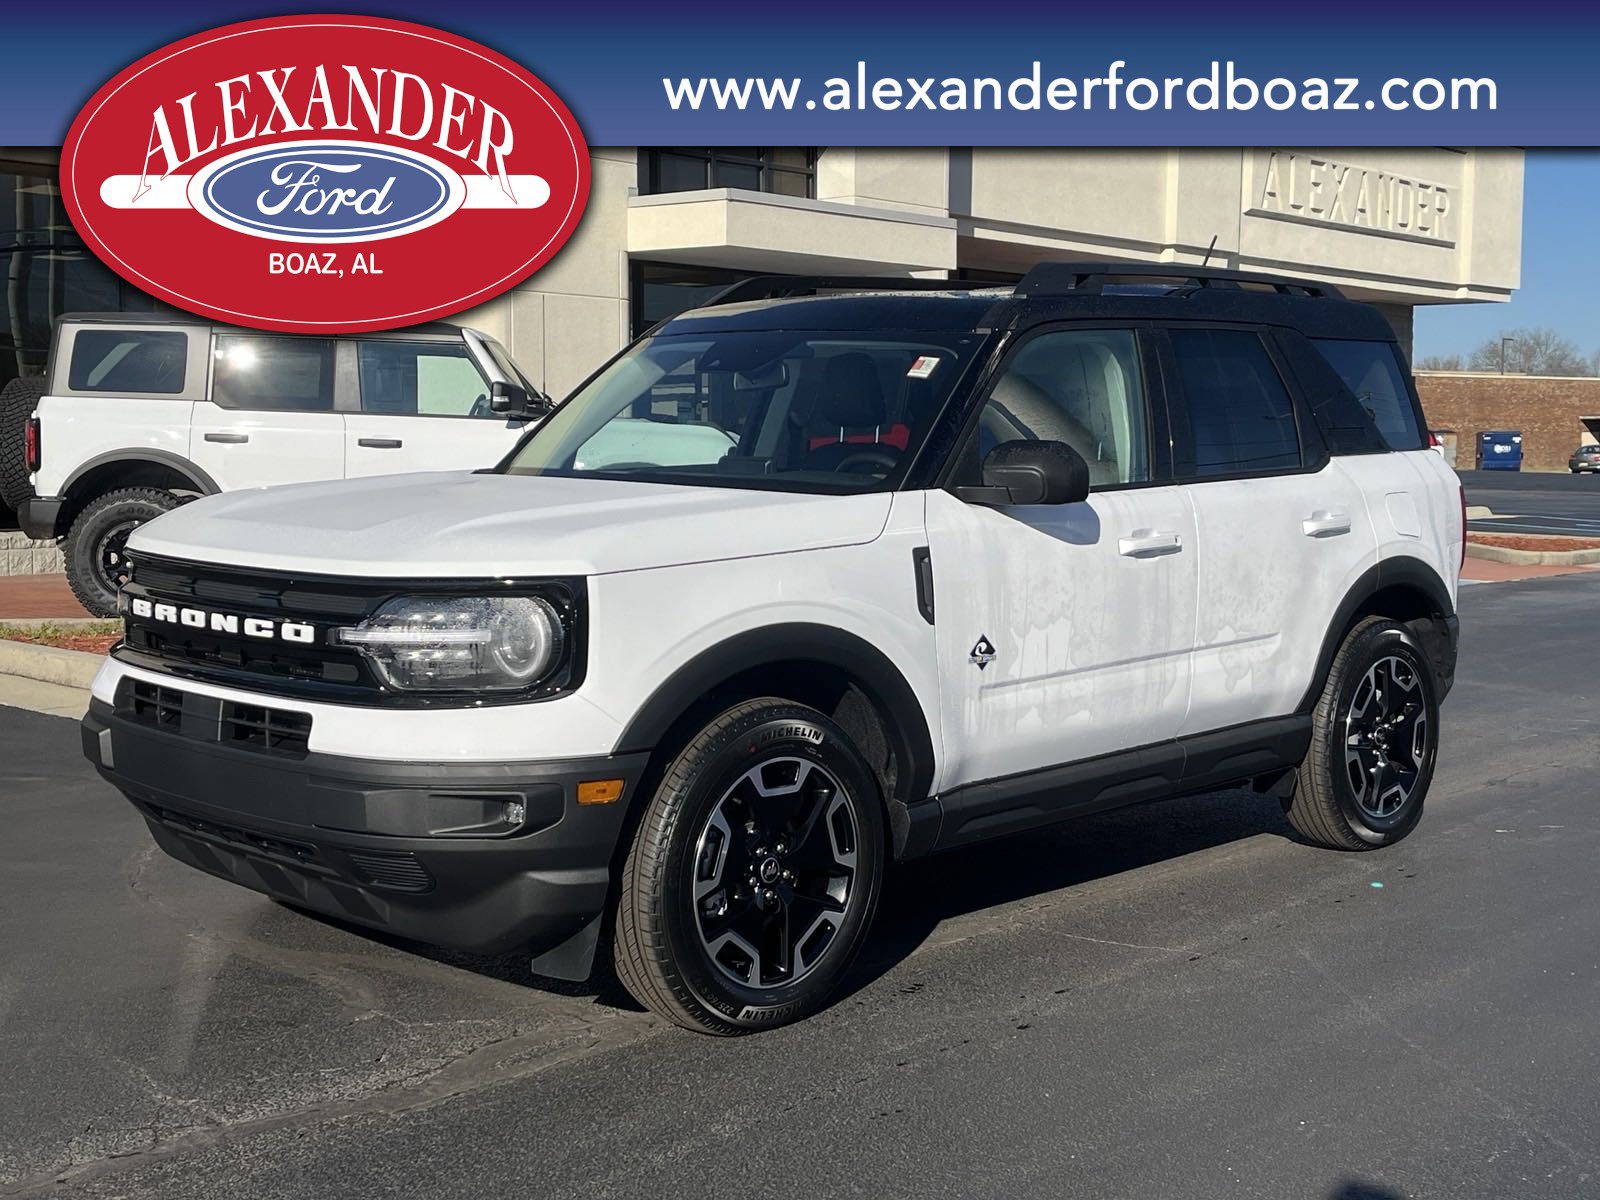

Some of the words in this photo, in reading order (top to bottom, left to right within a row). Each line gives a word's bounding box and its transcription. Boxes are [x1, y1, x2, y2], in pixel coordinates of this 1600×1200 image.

[1262, 152, 1450, 239] ALEXANDER
[131, 597, 315, 644] BRONCO
[760, 726, 822, 742] MICHELIN
